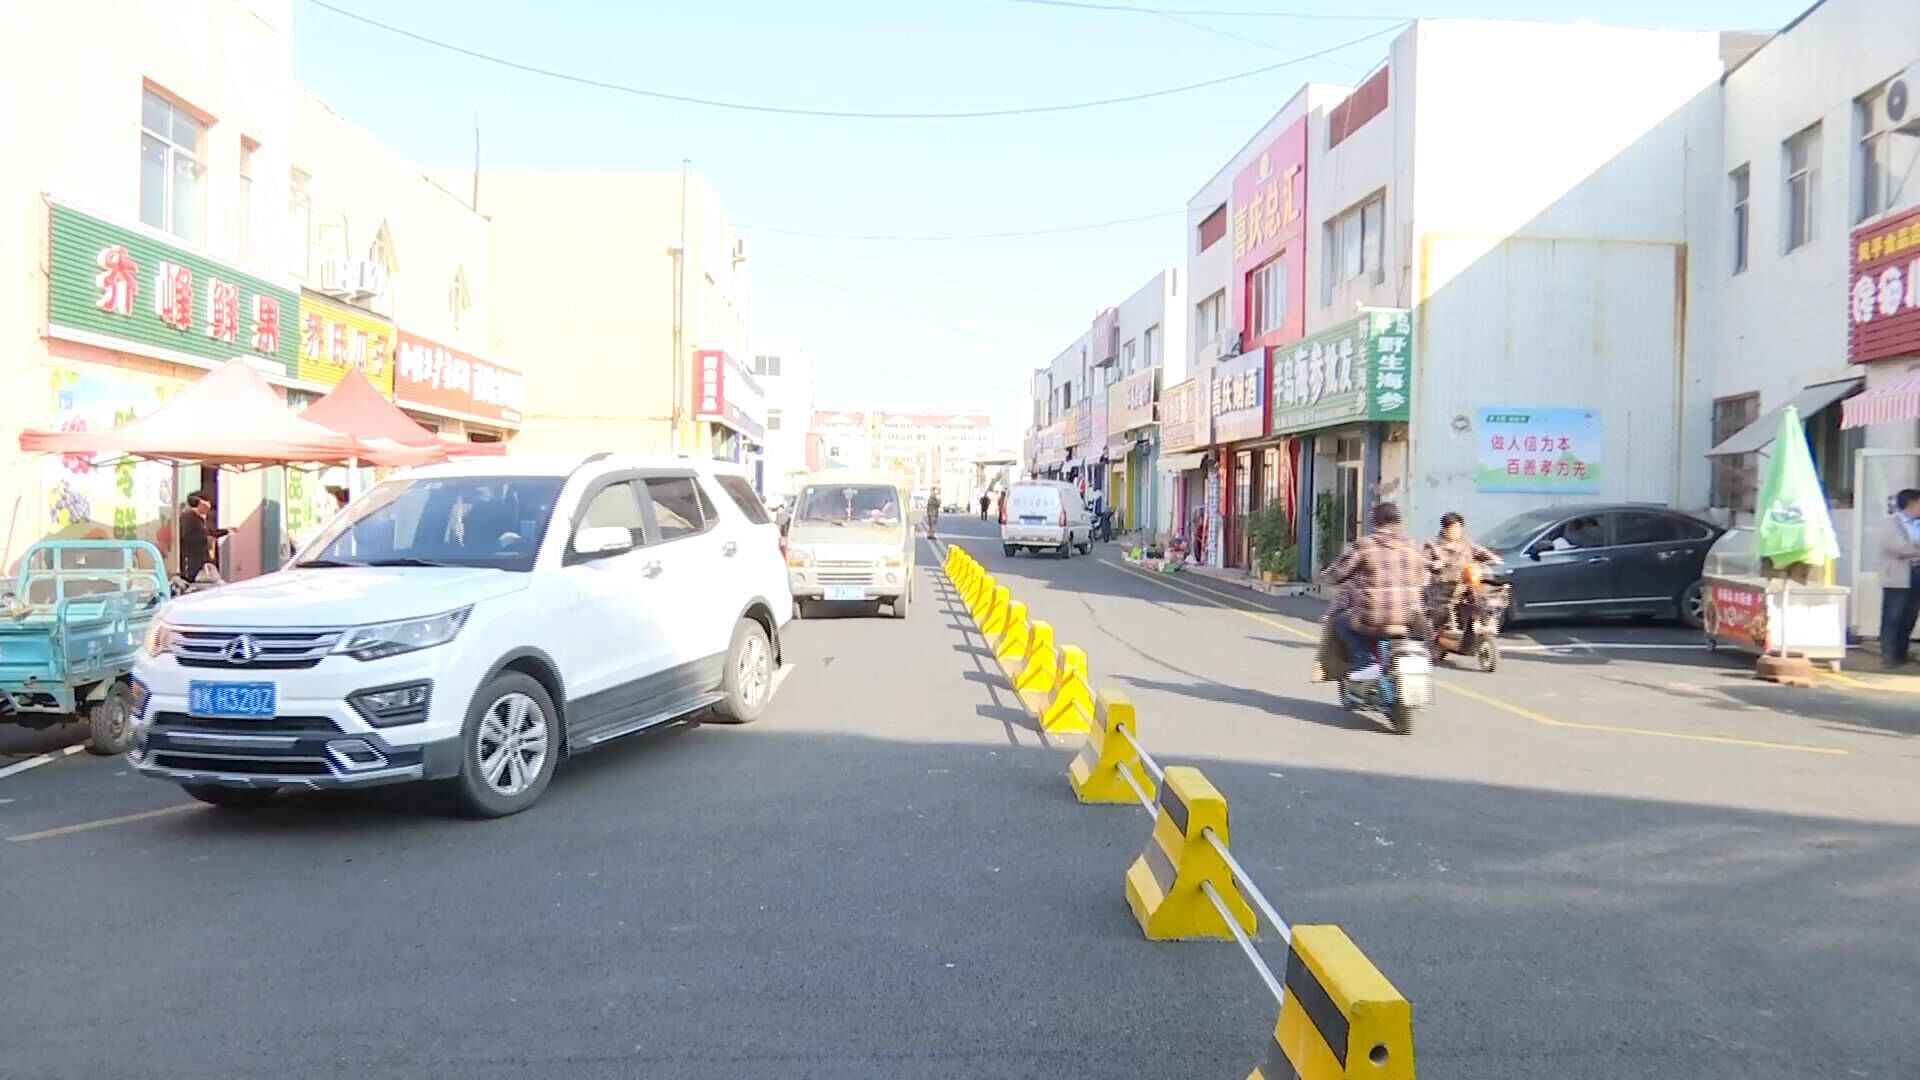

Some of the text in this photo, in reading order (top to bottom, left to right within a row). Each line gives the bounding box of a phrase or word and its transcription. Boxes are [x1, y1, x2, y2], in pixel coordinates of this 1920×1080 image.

[1233, 162, 1302, 260] 喜庆总汇
[96, 244, 282, 354] 乔峰鲜果
[1491, 433, 1571, 452] 做人信为本
[1507, 458, 1588, 479] 百善孝为先
